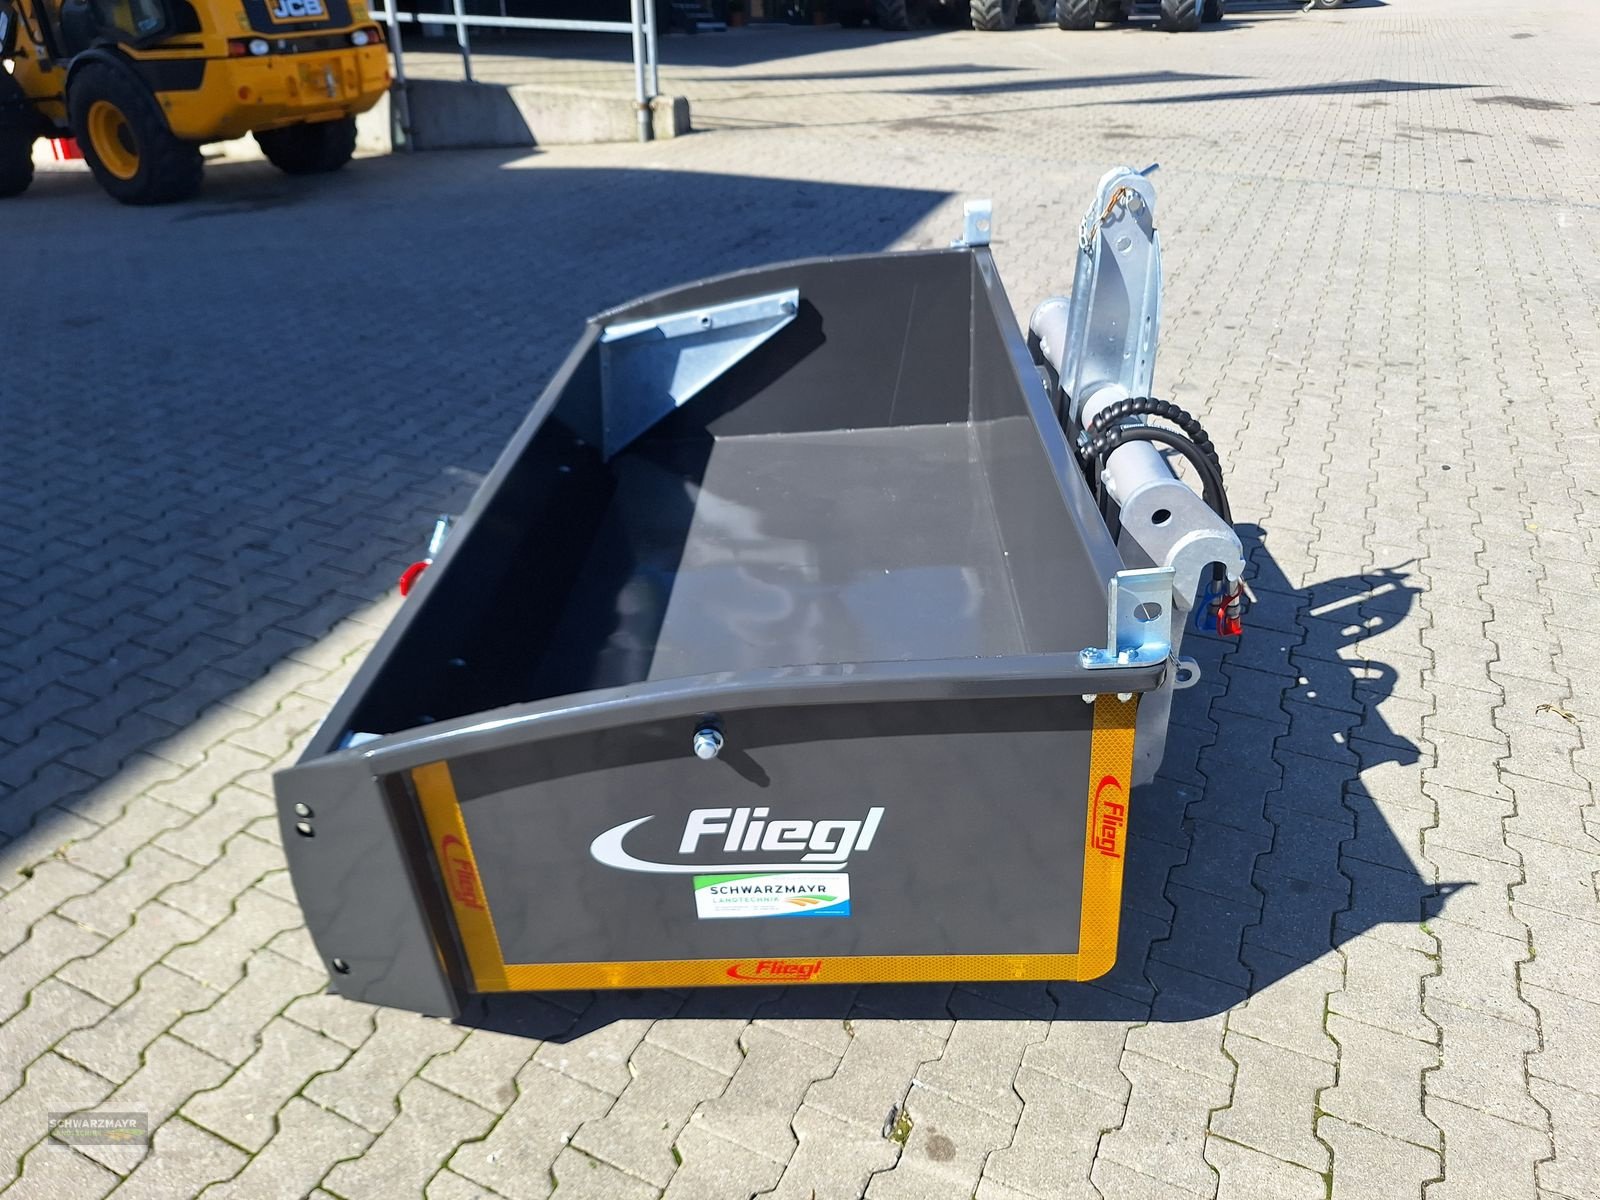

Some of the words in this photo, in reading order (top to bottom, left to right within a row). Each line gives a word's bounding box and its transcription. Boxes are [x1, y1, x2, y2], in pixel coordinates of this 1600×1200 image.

[274, 0, 323, 17] JCB
[679, 807, 885, 862] Fliegl
[1096, 801, 1124, 858] Fliegl
[710, 885, 827, 895] SCHWARZMAYR
[755, 959, 823, 980] Fliegl
